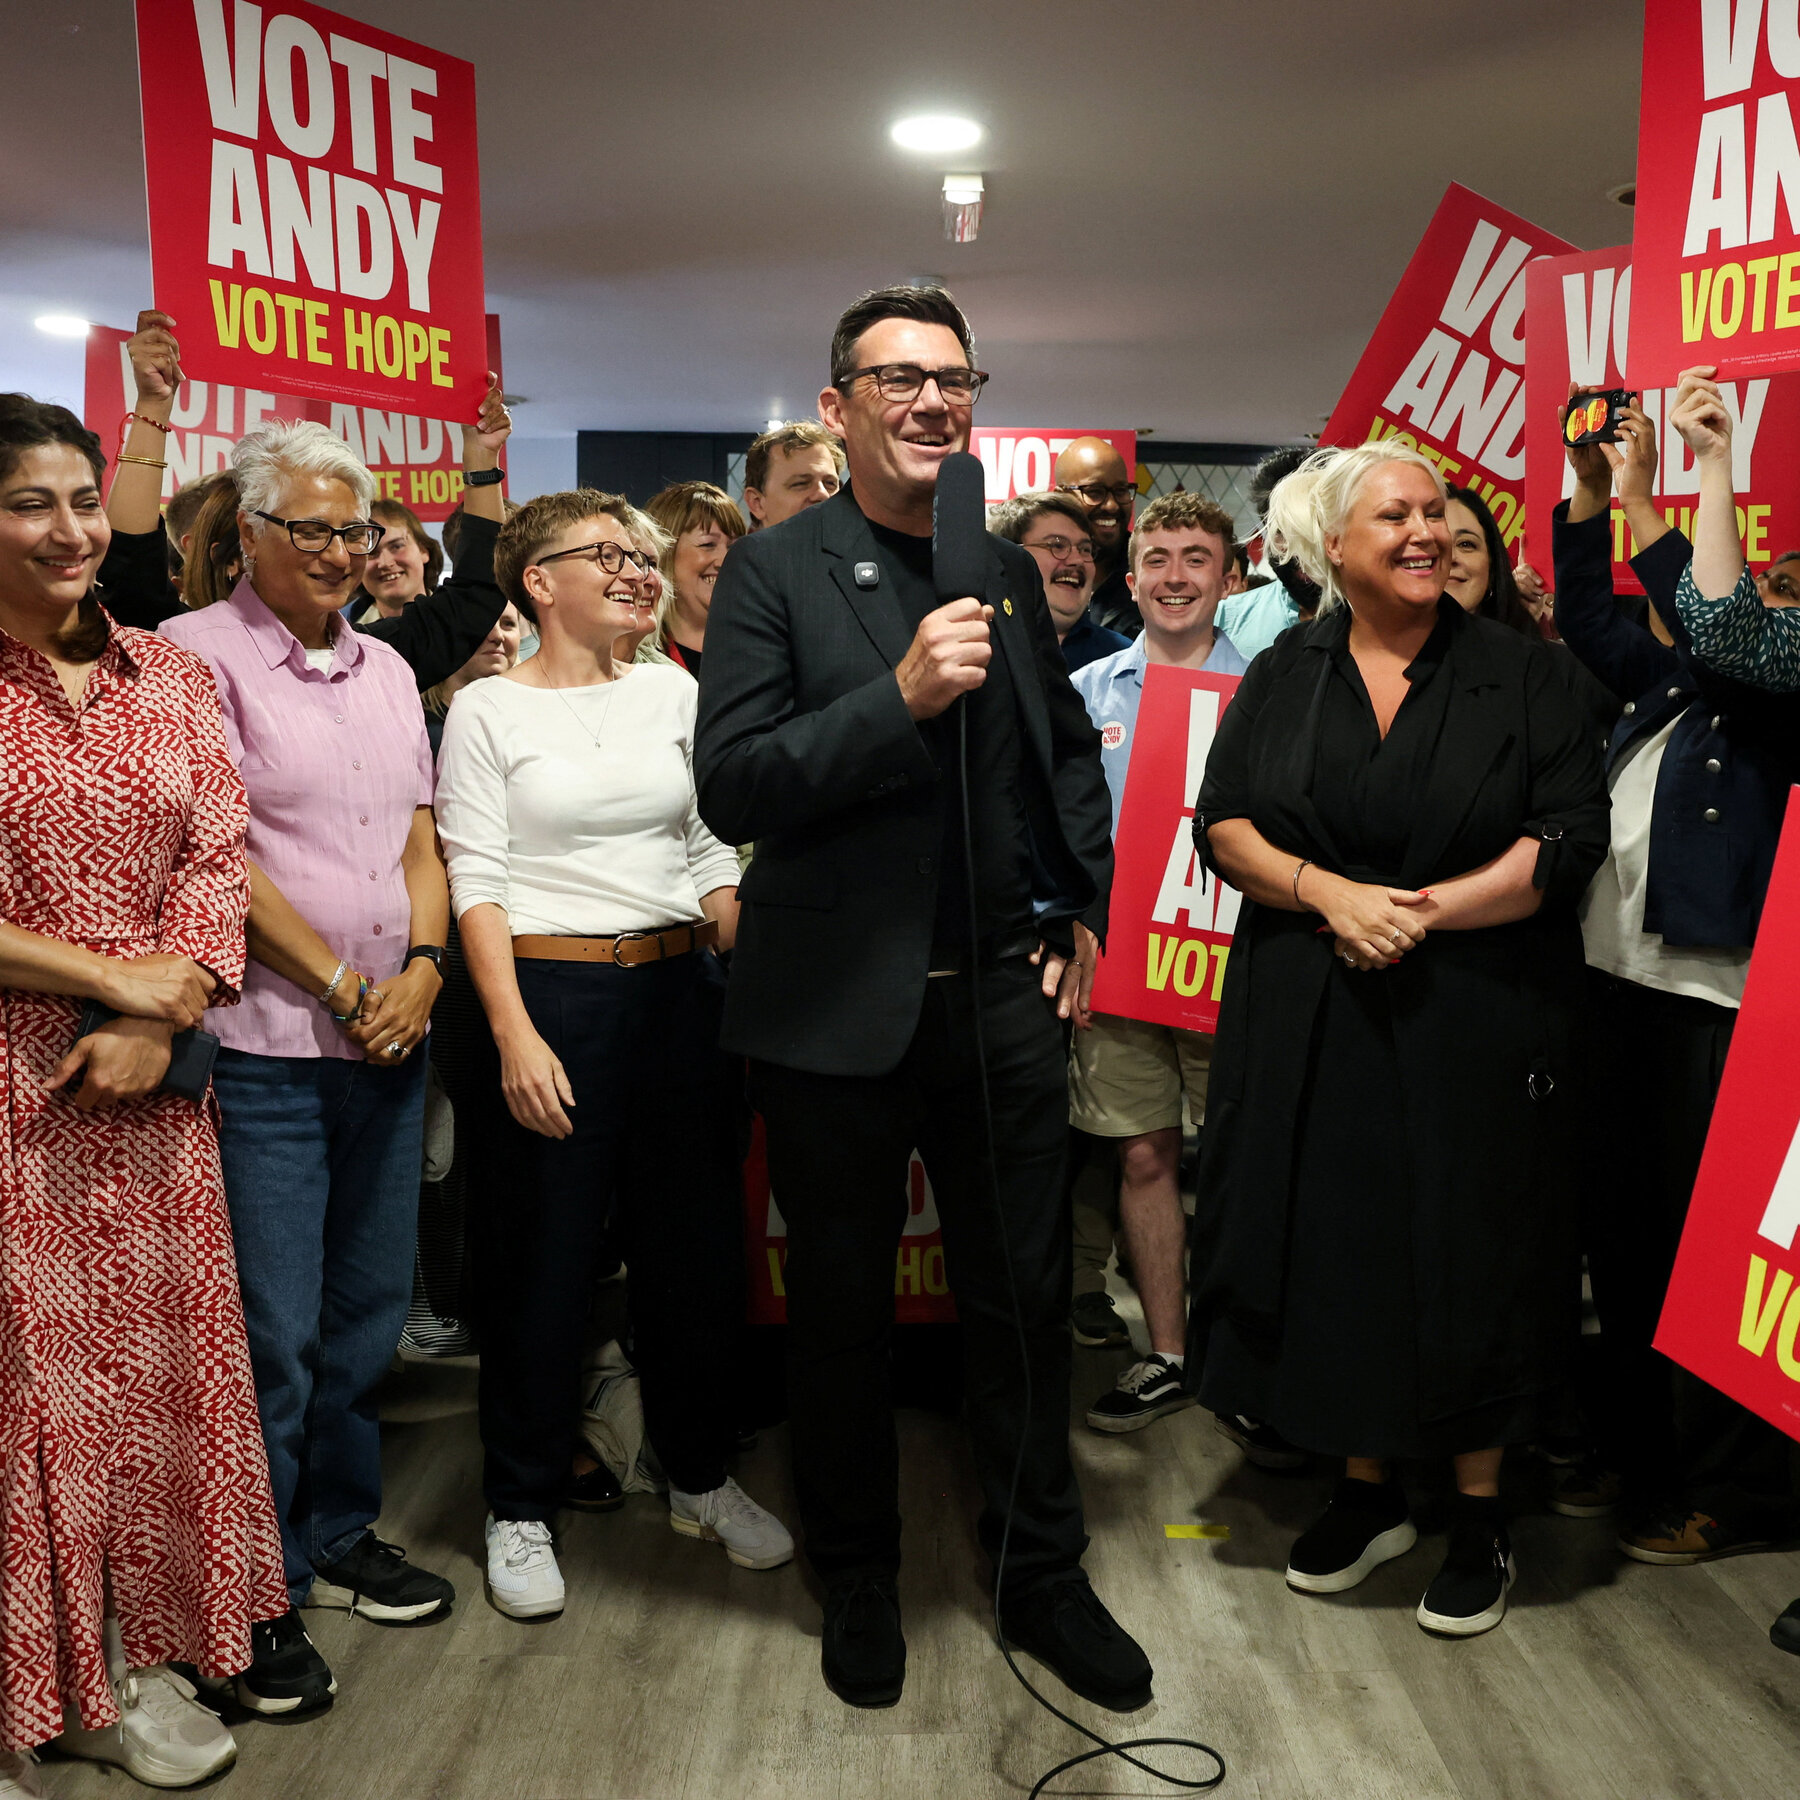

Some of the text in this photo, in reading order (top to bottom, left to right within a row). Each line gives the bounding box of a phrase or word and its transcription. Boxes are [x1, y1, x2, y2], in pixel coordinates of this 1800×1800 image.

[193, 0, 444, 195] VOTE
[207, 138, 442, 313] ANDY
[208, 278, 454, 388] VOTE HOPE
[410, 469, 464, 504] HOP
